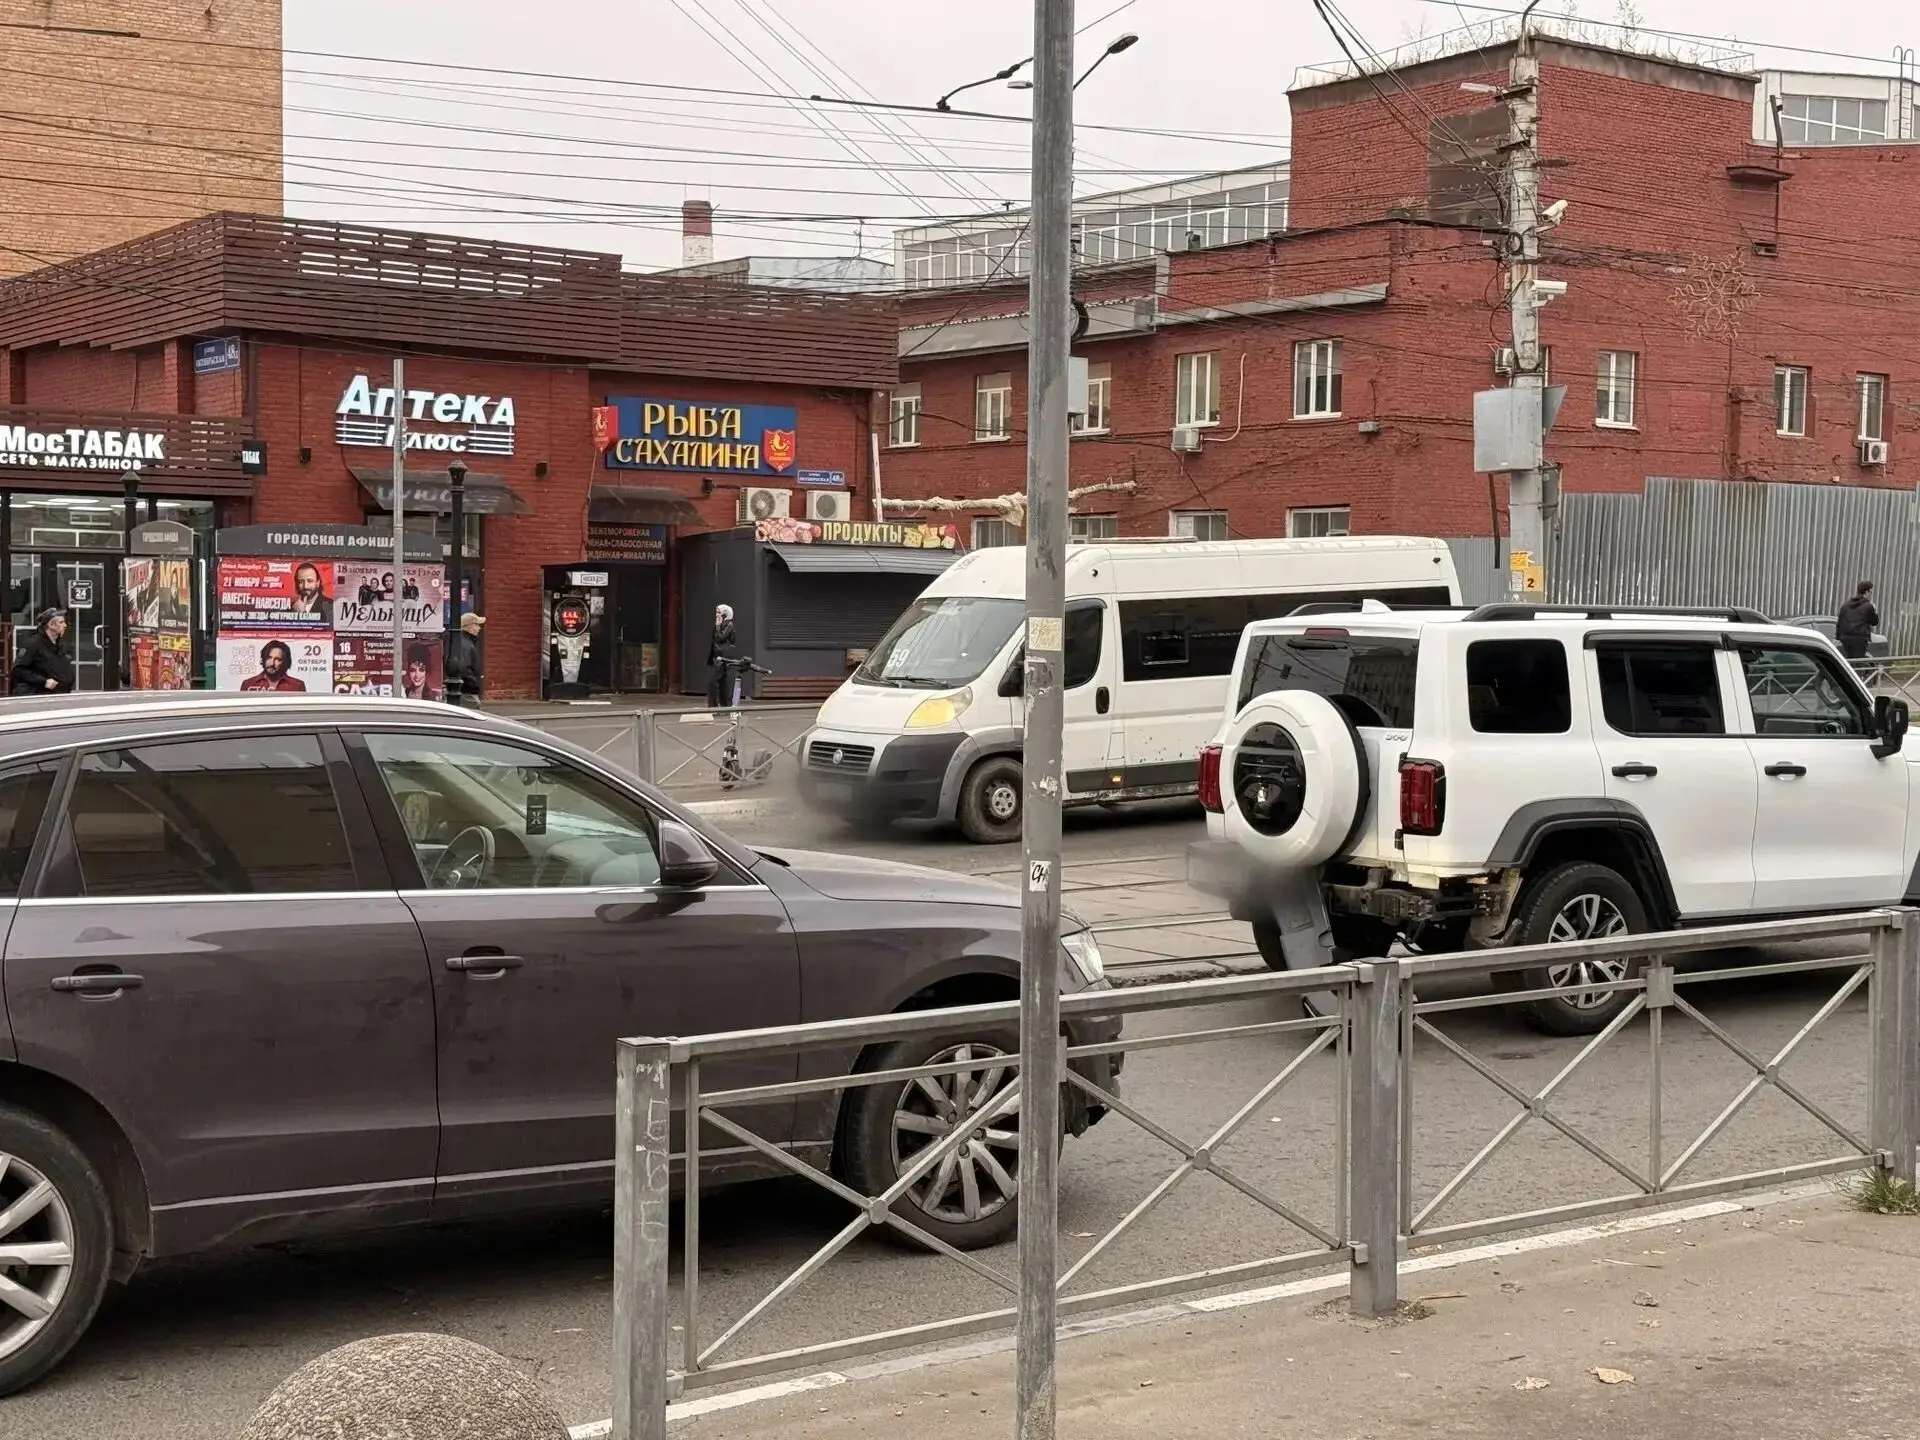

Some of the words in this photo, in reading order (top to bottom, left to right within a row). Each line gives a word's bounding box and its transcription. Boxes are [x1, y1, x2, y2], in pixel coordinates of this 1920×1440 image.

[643, 402, 742, 440] РЫБА
[616, 436, 760, 470] САХАЛИНА
[0, 453, 38, 466] СЕТЬ
[44, 456, 142, 470] МАГАЗИНОВ
[266, 532, 344, 546] ГОРОДСКАЯ
[588, 527, 650, 537] ВЕЖЕМОРОЖЕНАЯ
[822, 523, 902, 544] ПРОДУКТЫ
[336, 564, 348, 574] 18
[1526, 578, 1535, 588] 2
[222, 592, 251, 604] ВМЕСТЕ
[255, 597, 292, 610] НАВСЕГДА
[304, 645, 322, 656] 20
[340, 642, 351, 653] 16
[886, 648, 910, 668] 59
